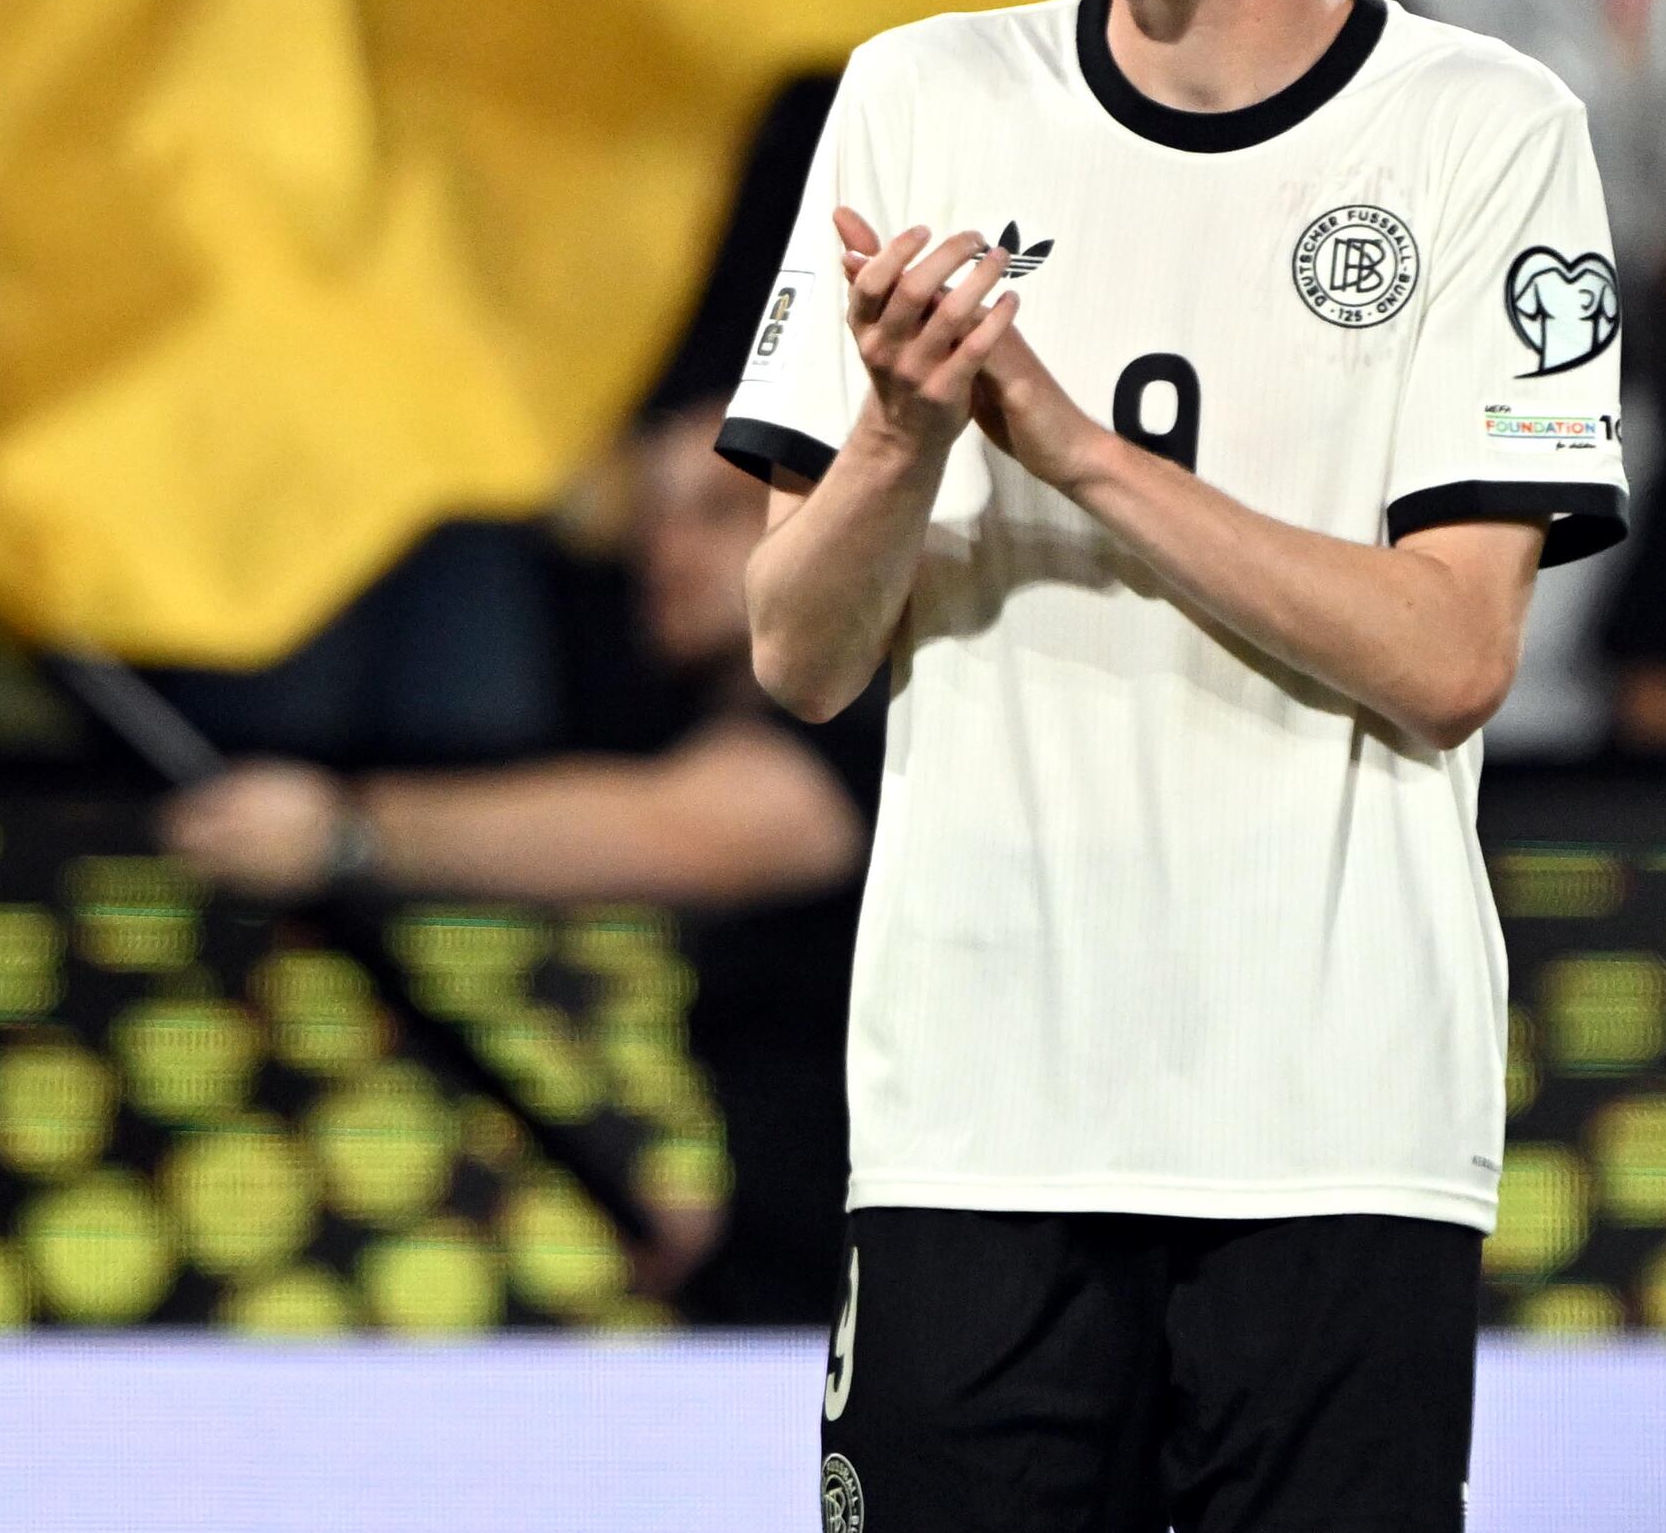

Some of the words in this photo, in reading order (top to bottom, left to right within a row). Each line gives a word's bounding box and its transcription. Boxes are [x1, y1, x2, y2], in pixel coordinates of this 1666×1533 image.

[1298, 216, 1339, 308] DEUTSCHER
[1338, 308, 1363, 322] 125
[1112, 352, 1201, 474] 9
